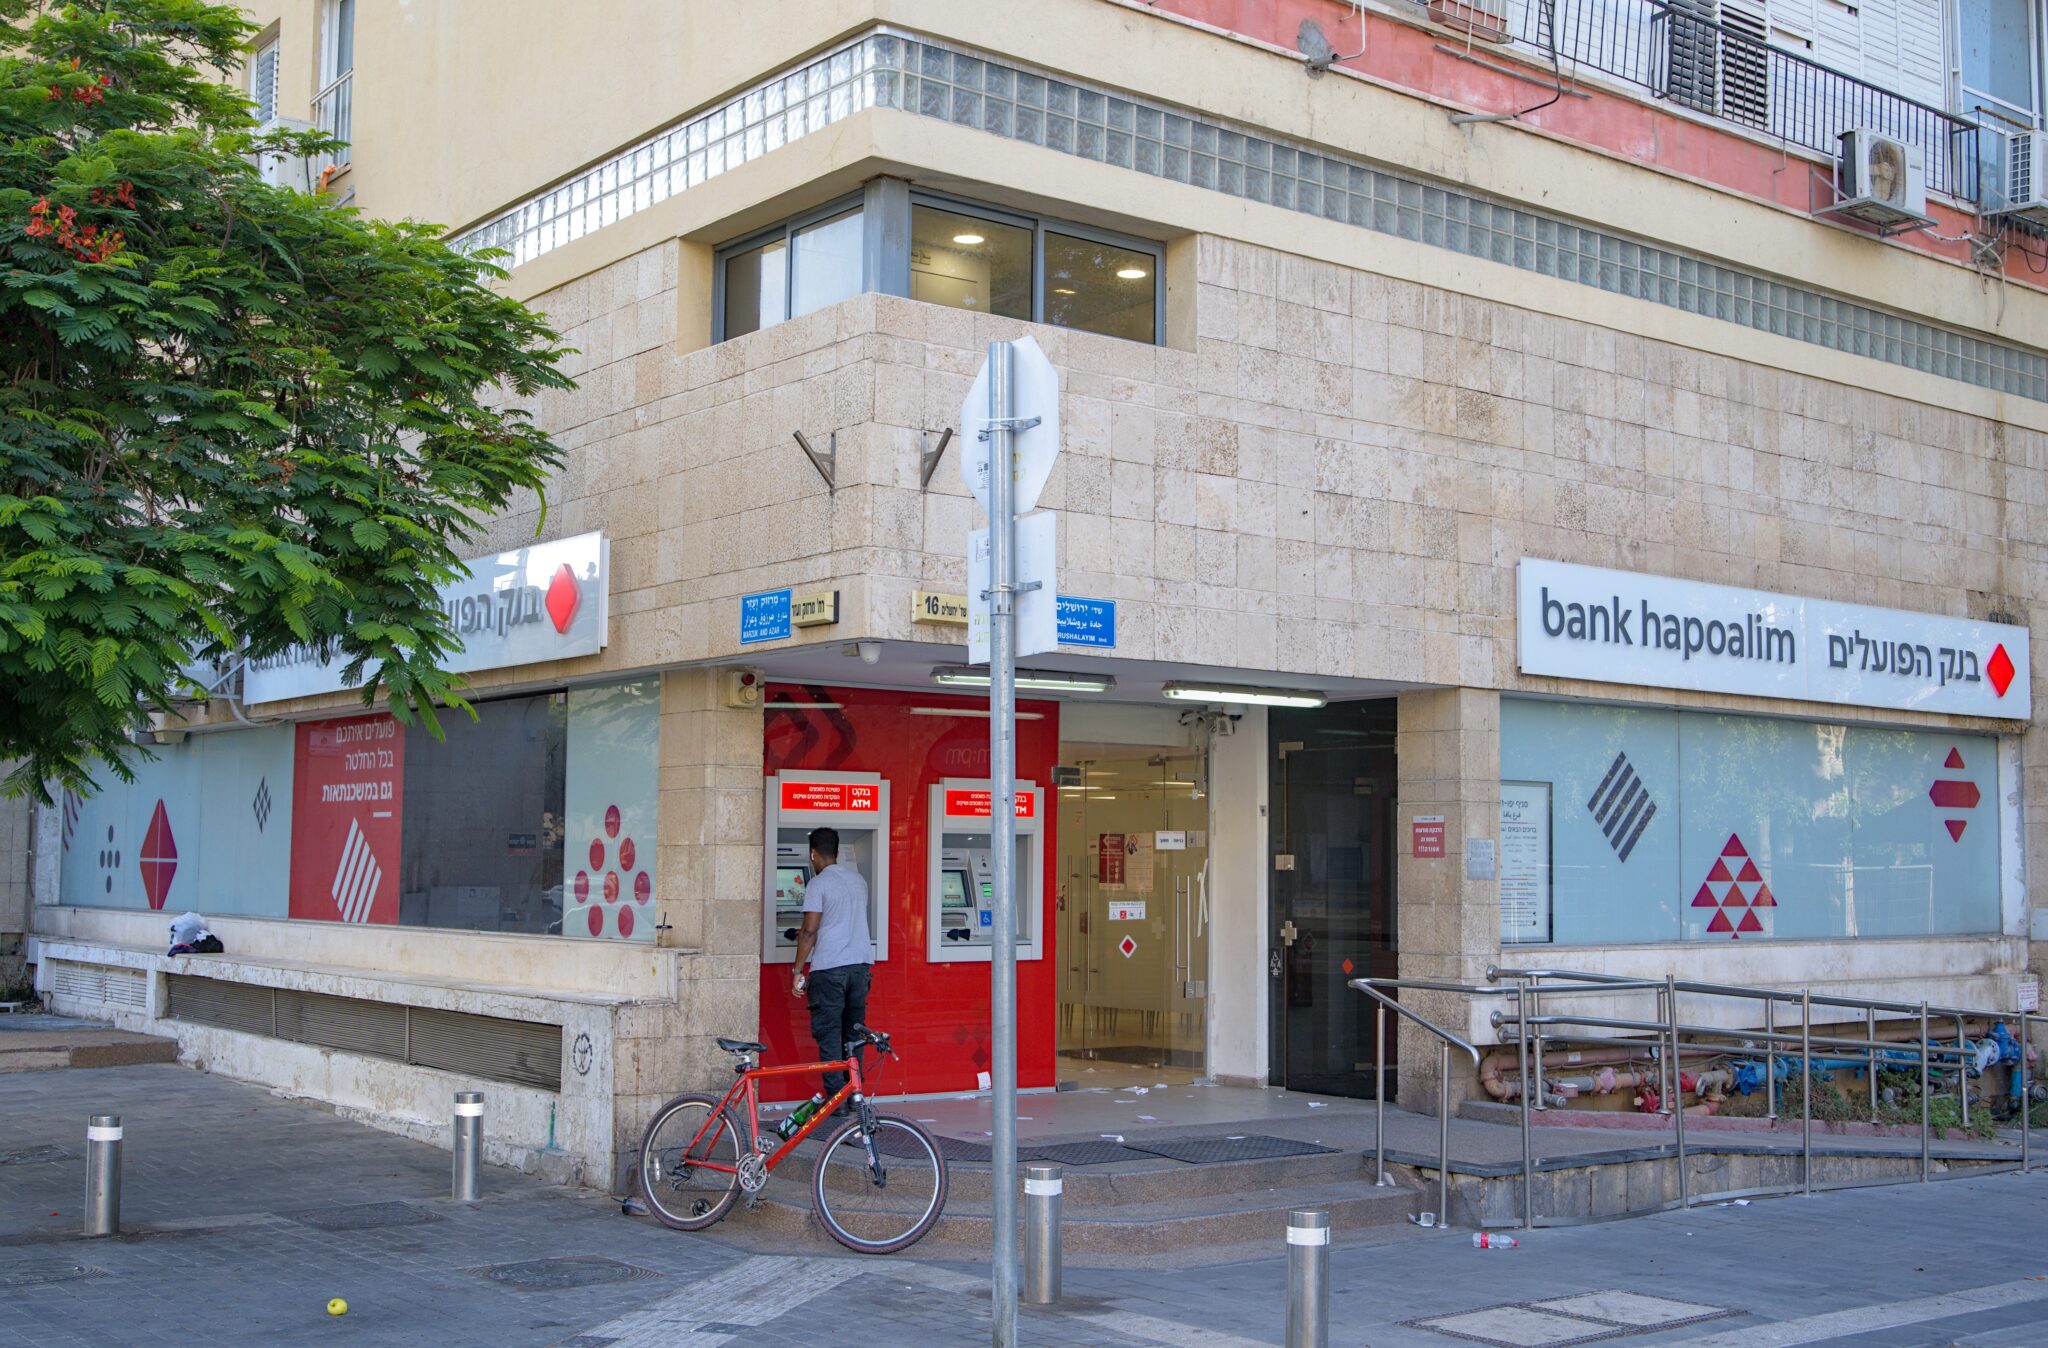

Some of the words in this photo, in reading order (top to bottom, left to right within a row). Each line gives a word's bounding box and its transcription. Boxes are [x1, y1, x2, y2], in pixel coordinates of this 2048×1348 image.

[440, 593, 492, 634] הפוע
[498, 586, 542, 636] בנק
[925, 595, 939, 615] 16
[759, 628, 768, 637] AND
[1541, 587, 1633, 646] bank
[1641, 599, 1796, 664] hapoalim
[1057, 632, 1095, 641] RUSHALAYIM
[1828, 629, 1932, 678] הפועלים
[1938, 648, 1981, 686] בנק
[336, 724, 363, 744] איתכם
[365, 718, 395, 740] פועלים
[345, 749, 376, 771] החלטה
[377, 747, 394, 768] בכל
[322, 782, 379, 802] במשכנתאות
[380, 780, 393, 800] גם
[852, 787, 871, 797] בנקט
[1015, 795, 1027, 804] בנק
[851, 799, 871, 808] ATM
[1015, 806, 1027, 814] TM
[802, 1091, 843, 1131] KLEIN
